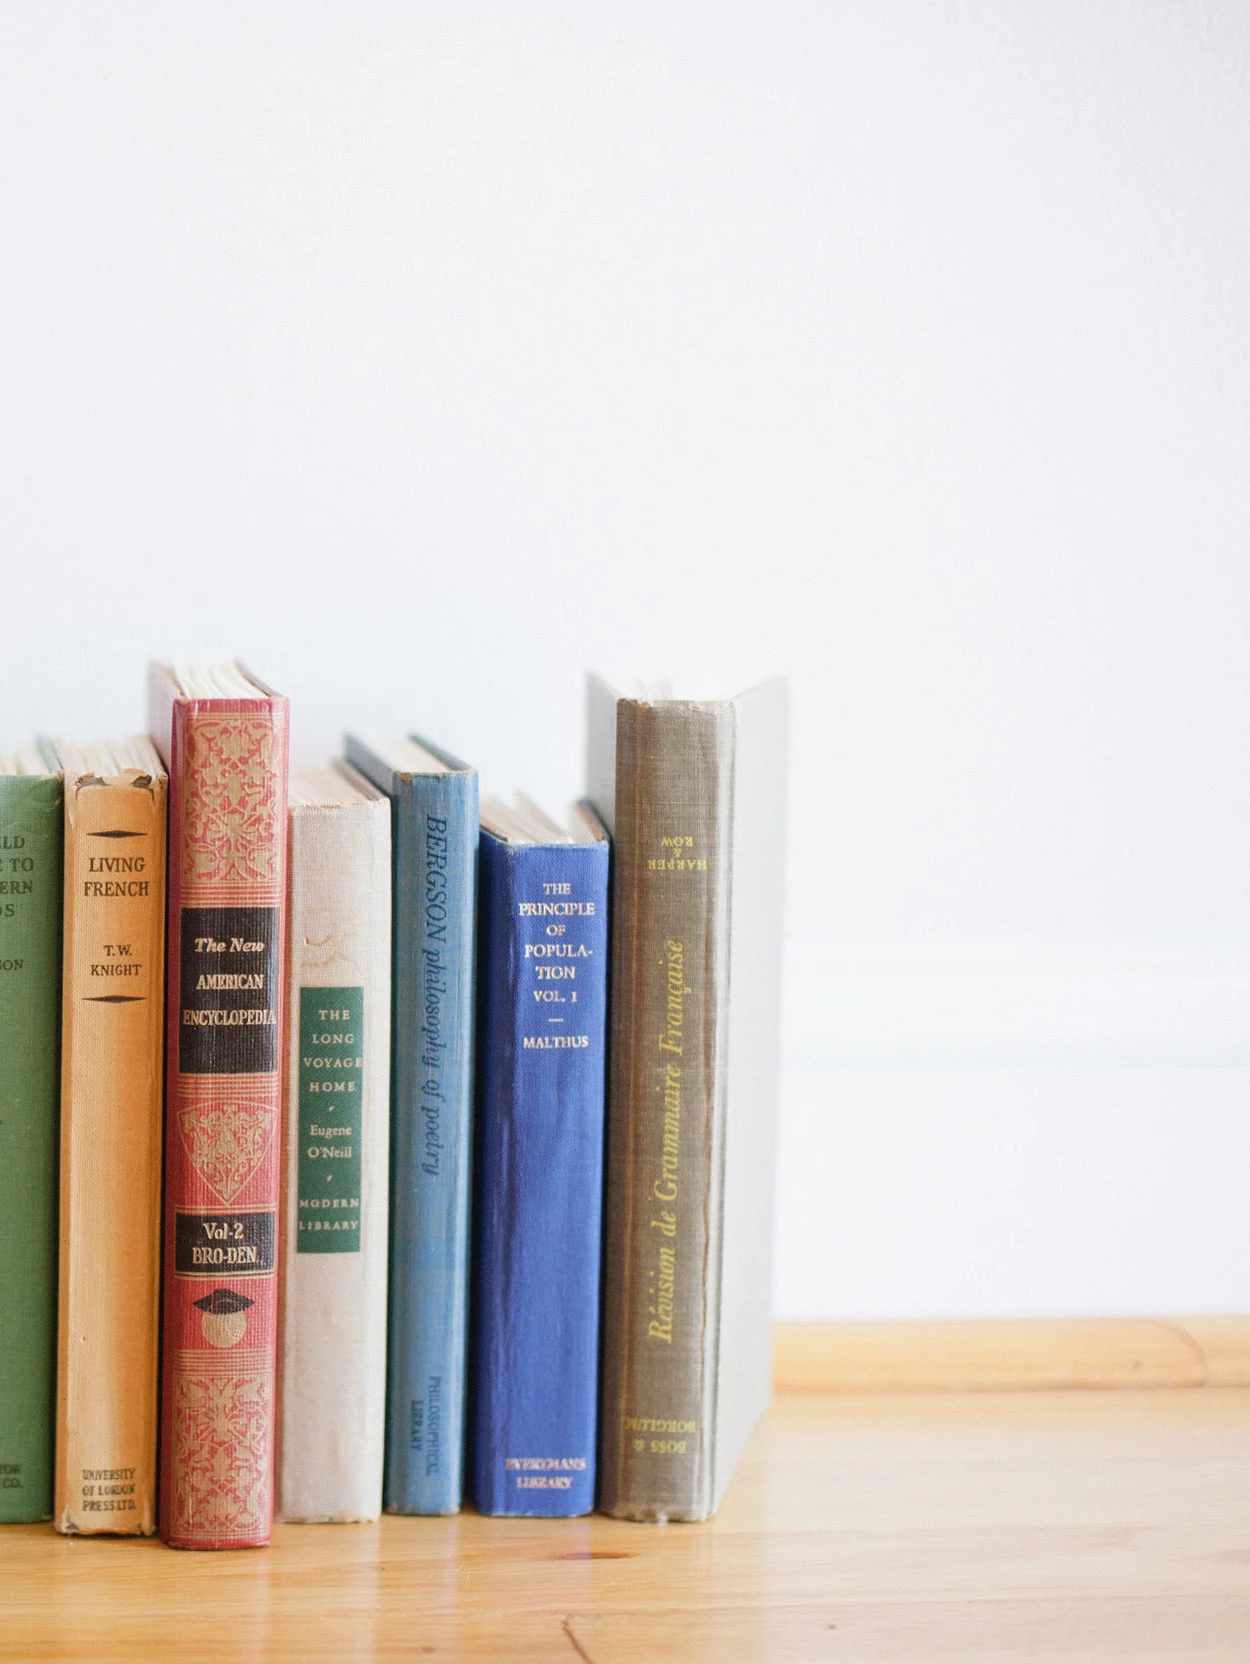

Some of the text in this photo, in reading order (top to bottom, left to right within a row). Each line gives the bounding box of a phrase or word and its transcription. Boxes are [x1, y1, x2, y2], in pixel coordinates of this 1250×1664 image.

[661, 836, 694, 847] ROW
[673, 848, 683, 858] &
[10, 857, 34, 872] TO
[88, 857, 145, 873] LIVING
[647, 860, 707, 870] HARPER
[84, 881, 150, 897] FRENCH
[543, 883, 571, 895] THE
[518, 903, 595, 916] PRINCIPLE
[546, 925, 566, 936] OF
[195, 938, 265, 953] The New
[524, 944, 593, 958] POPULA-
[91, 964, 142, 976] KNIGHT
[535, 966, 576, 979] TION
[196, 974, 265, 990] AMERICAN
[421, 814, 447, 1176] BERGSON philosophy of poetry
[534, 991, 565, 1002] VOL.
[182, 1009, 277, 1026] ENCYCLOPEDIA
[318, 1009, 350, 1020] THE
[312, 1034, 355, 1044] LONG
[523, 1035, 589, 1048] MALTHUS
[303, 1057, 363, 1068] VOYAGE
[309, 1082, 355, 1092] HOME
[310, 1125, 352, 1139] Eugene
[648, 940, 691, 1343] Révision de Grammaire Française
[307, 1146, 352, 1158] O'Neill
[300, 1199, 359, 1208] MODERN
[299, 1220, 359, 1230] LIBRARY
[82, 1468, 136, 1480] UNIVERSITY
[82, 1484, 135, 1496] OF LONDON
[82, 1500, 137, 1511] PRESS LTD.
